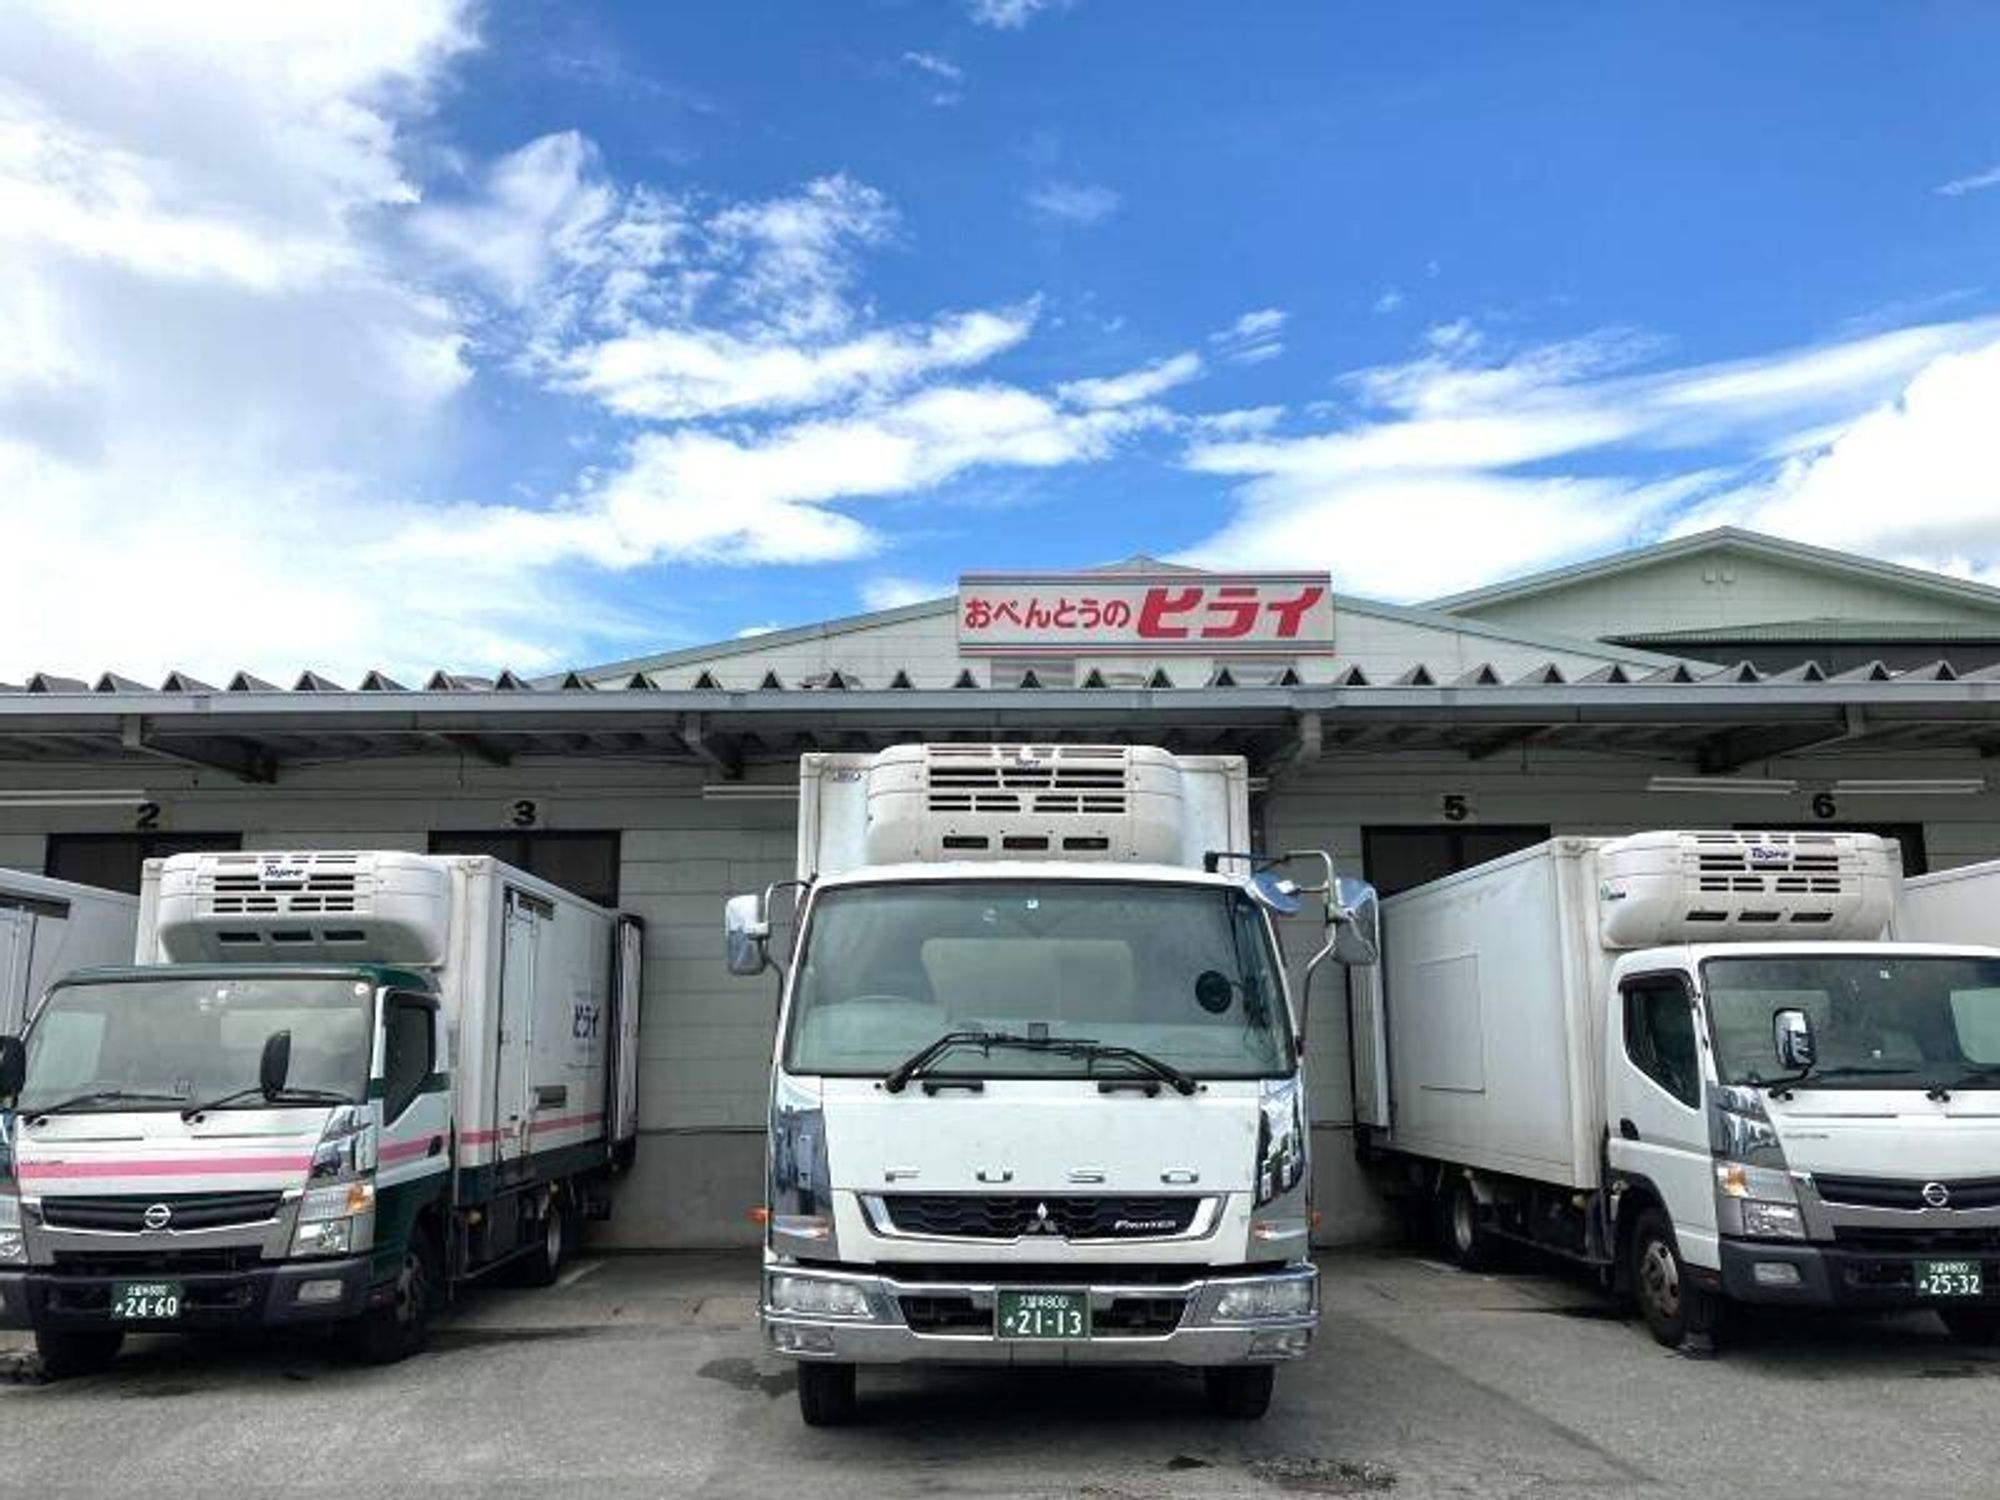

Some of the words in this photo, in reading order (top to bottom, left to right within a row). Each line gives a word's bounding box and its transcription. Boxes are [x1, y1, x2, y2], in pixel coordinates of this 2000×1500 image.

[964, 598, 1131, 629] おべんとうの
[1137, 587, 1324, 638] ヒライ
[137, 802, 161, 829] 2
[513, 800, 536, 826] 3
[1443, 795, 1468, 821] 5
[1812, 793, 1836, 818] 6
[885, 1169, 1200, 1184] FUSO
[1930, 1275, 1980, 1294] 25-32
[125, 1297, 177, 1317] 24-60
[1017, 1310, 1081, 1334] 21-13
